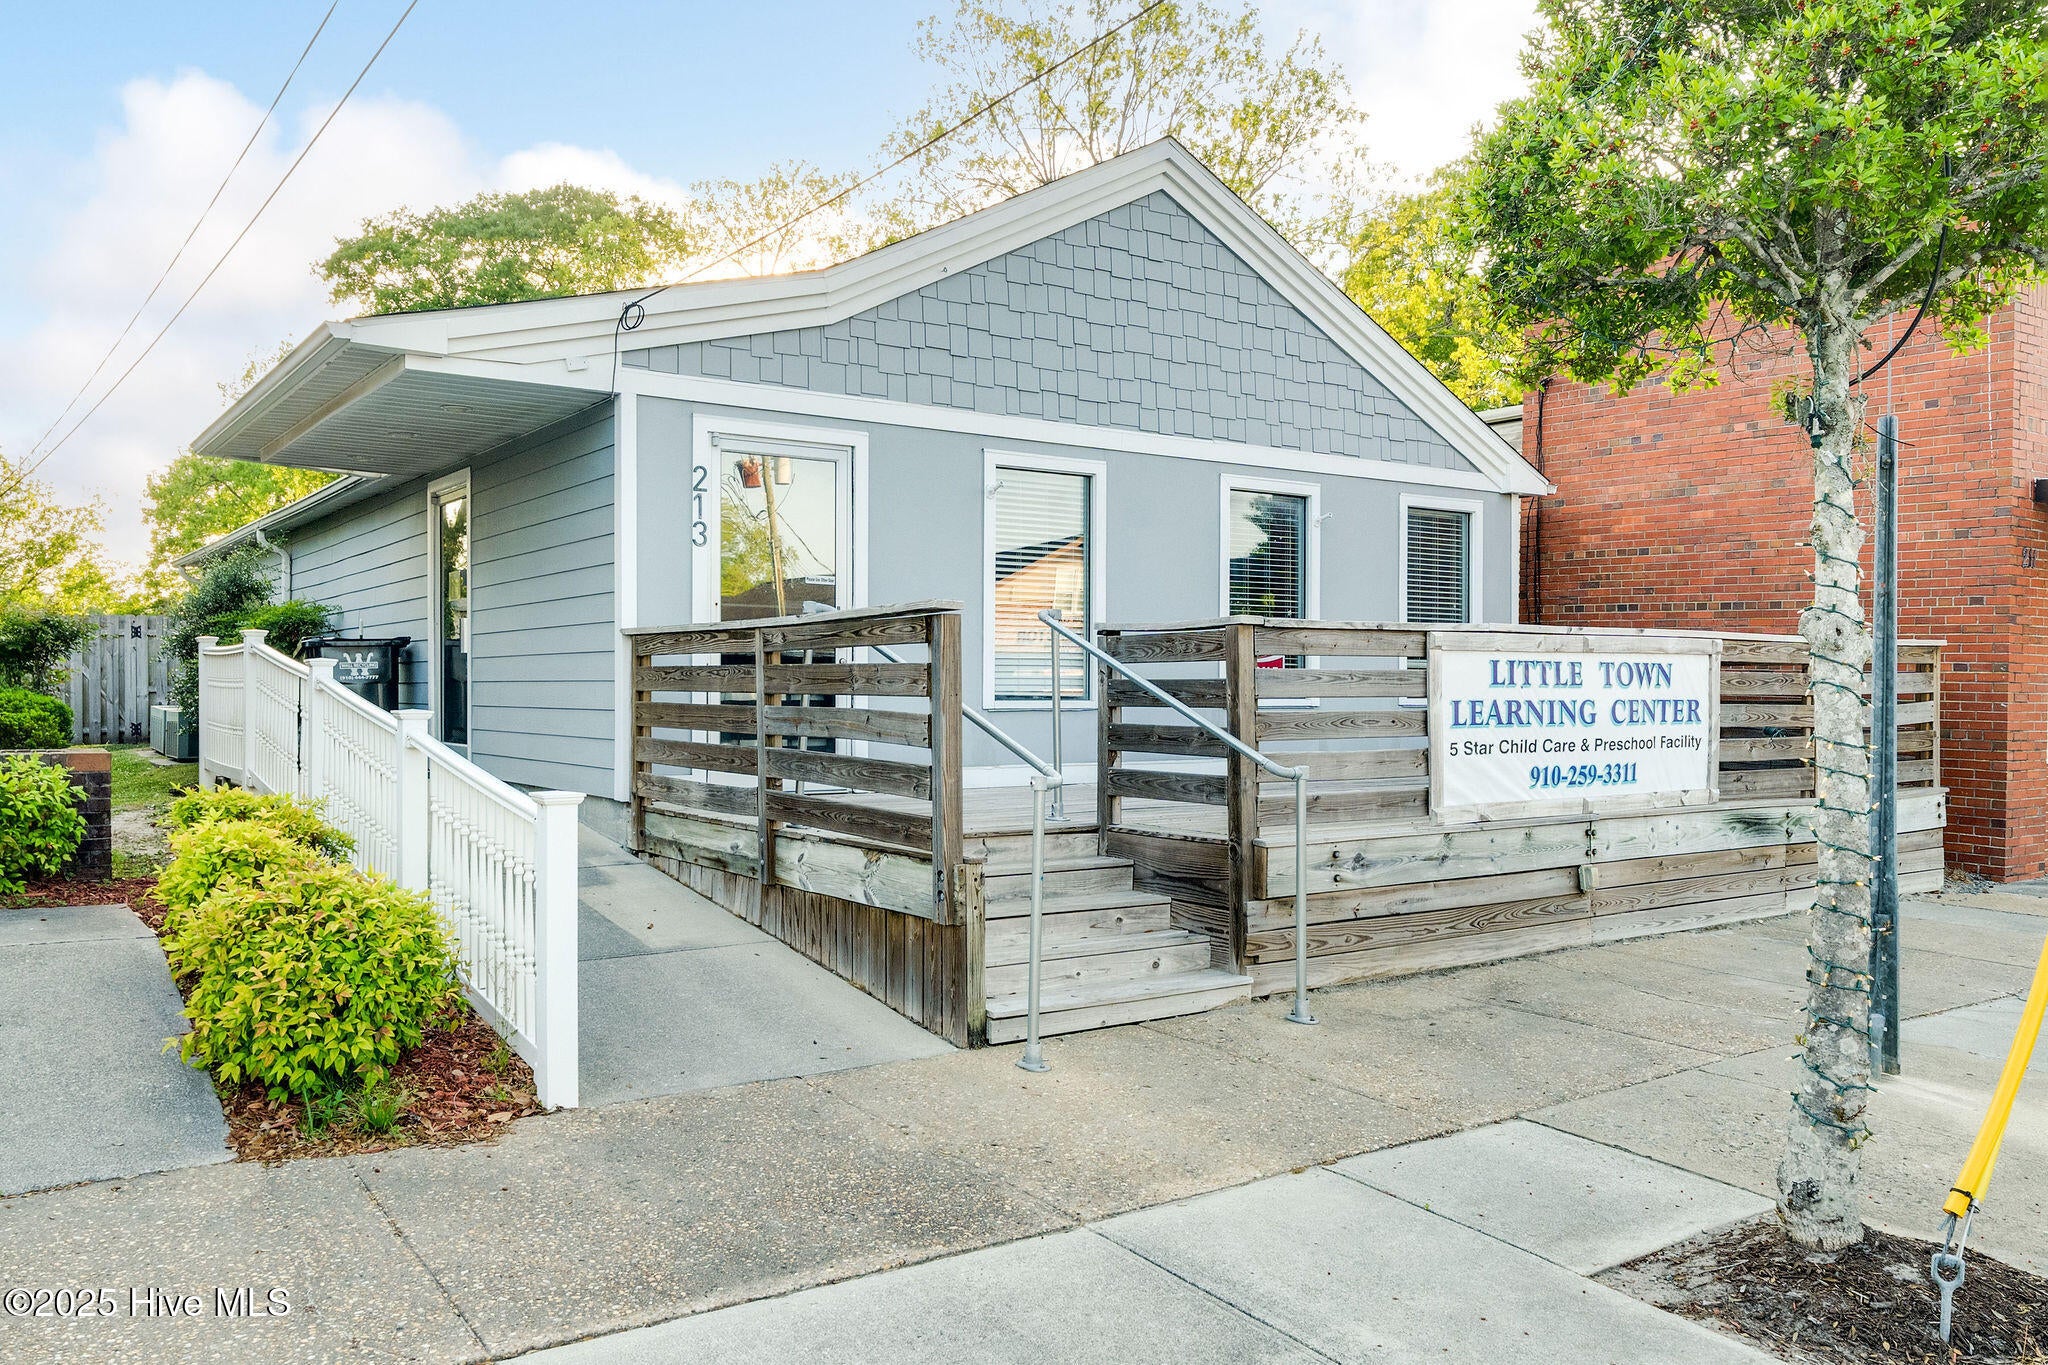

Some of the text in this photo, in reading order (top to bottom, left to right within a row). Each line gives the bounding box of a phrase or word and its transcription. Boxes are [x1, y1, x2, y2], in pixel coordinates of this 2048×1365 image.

[692, 465, 708, 547] 213
[1489, 659, 1673, 689] LITTLE TOWN
[1450, 699, 1702, 728] LEARNING CENTER
[1449, 734, 1702, 757] 5 Star Child Care & Preschool Facility
[1529, 762, 1638, 789] 910-259-3311
